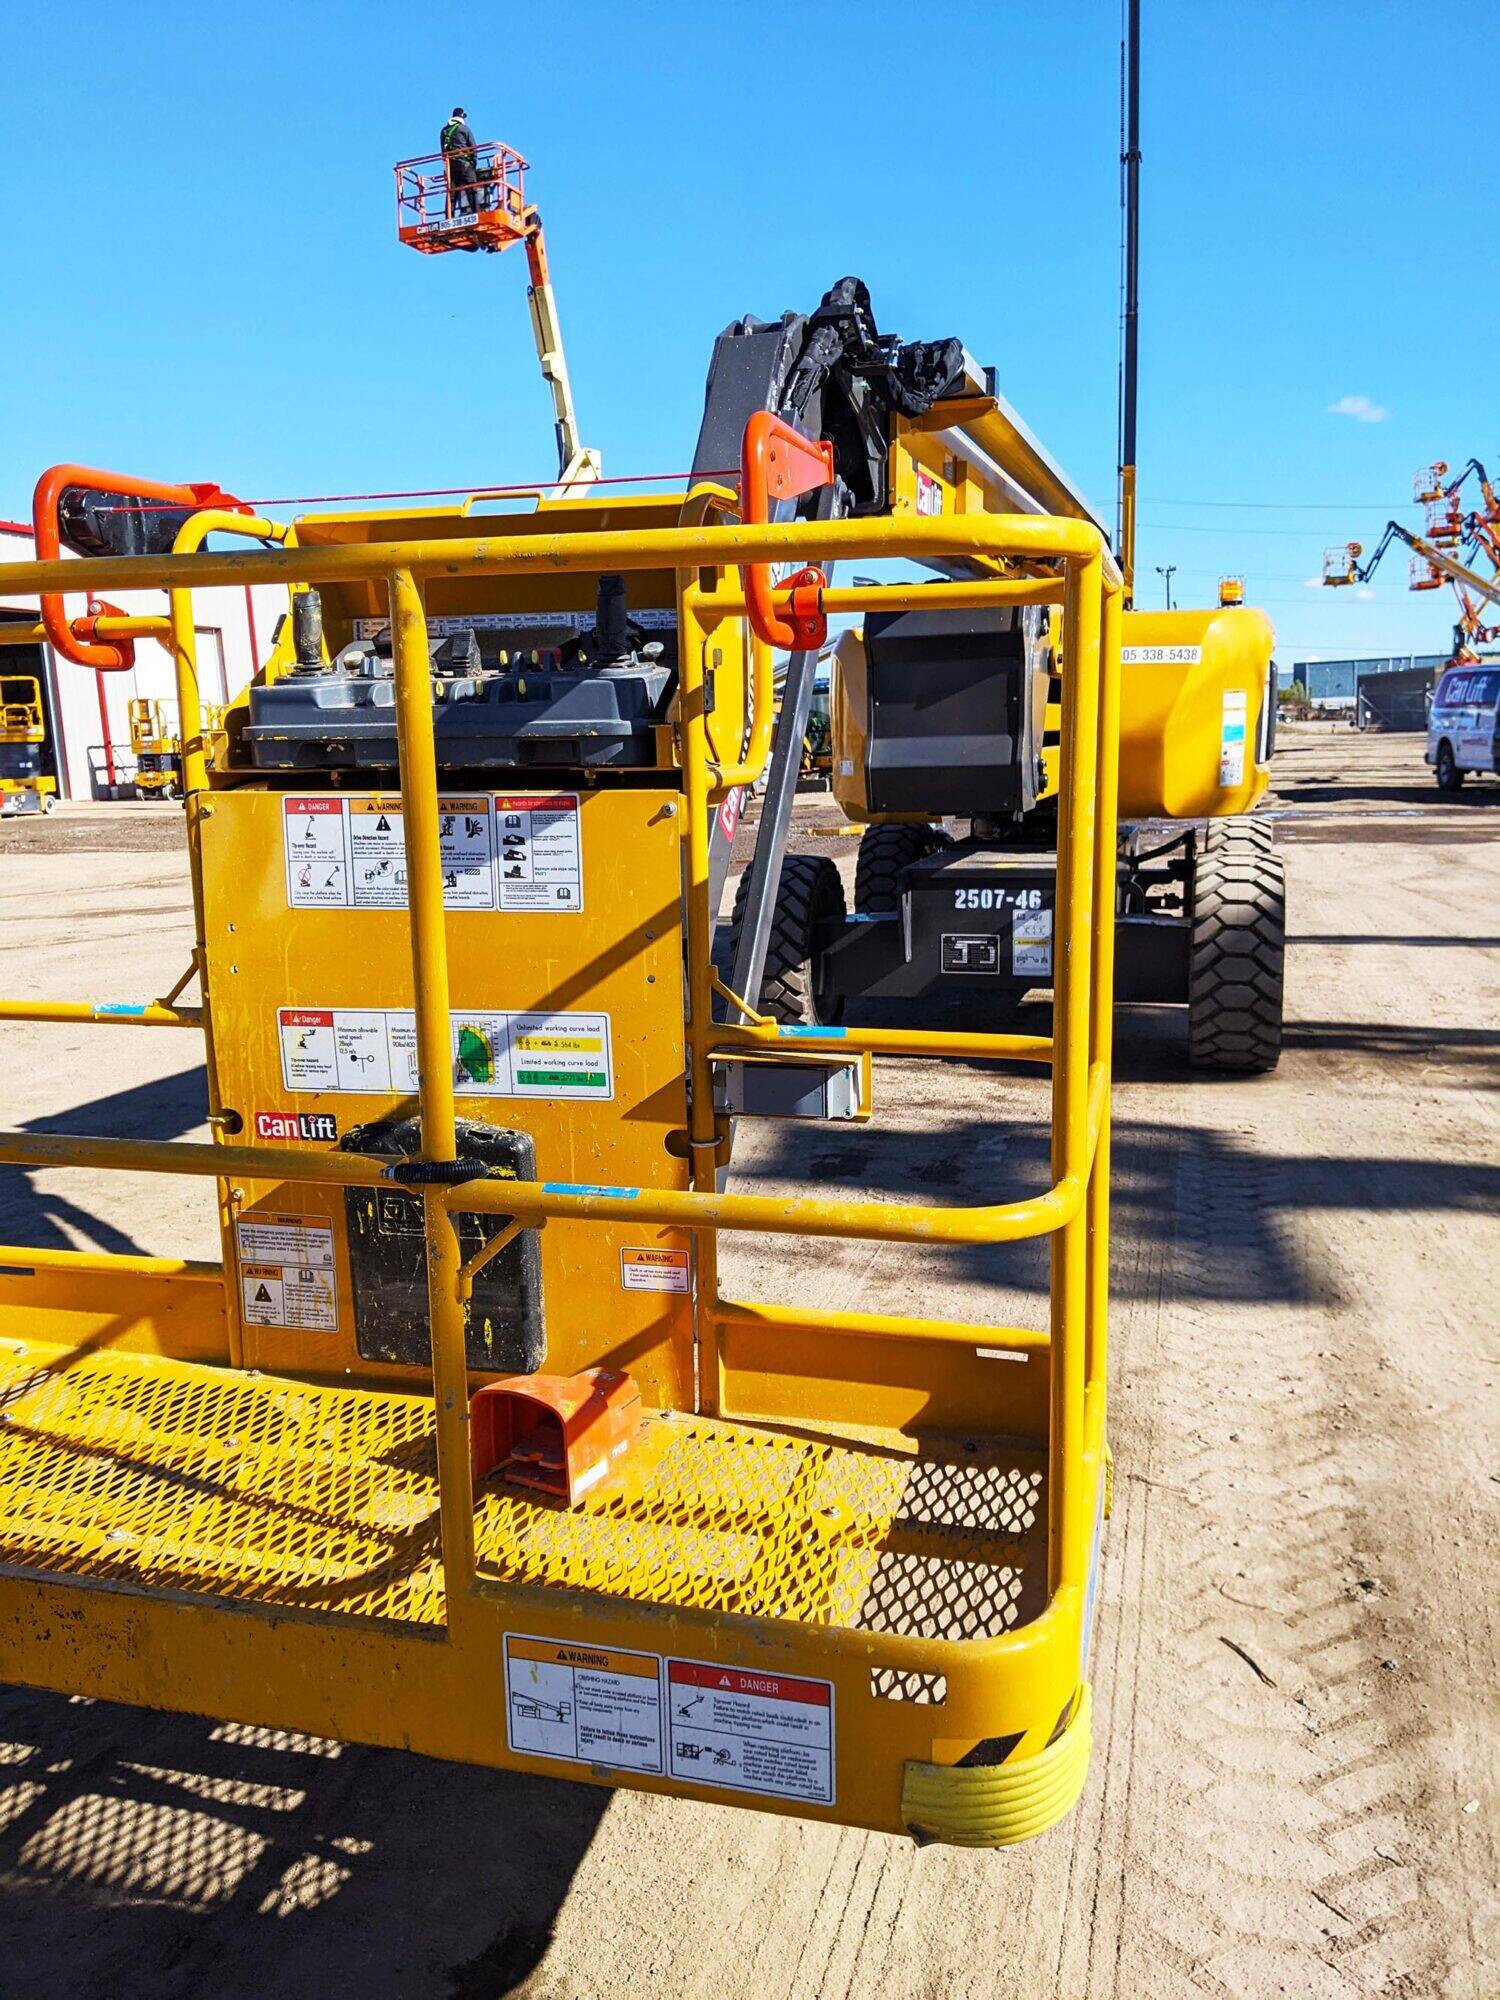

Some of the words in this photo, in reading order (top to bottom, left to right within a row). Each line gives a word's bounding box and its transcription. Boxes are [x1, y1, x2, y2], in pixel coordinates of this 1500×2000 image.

[1122, 648, 1198, 661] 05-338-5438
[308, 802, 330, 811] DANGER
[450, 802, 478, 811] WARNING
[954, 889, 1042, 910] 2507-46
[302, 1016, 321, 1025] Danger
[543, 1059, 566, 1067] working
[258, 1115, 334, 1138] CanLift
[646, 1254, 673, 1262] WARNING
[568, 1650, 609, 1667] WARNING
[740, 1678, 779, 1694] DANGER
[580, 1725, 595, 1733] Failure
[616, 1731, 628, 1739] these
[629, 1733, 655, 1743] instructions
[631, 1740, 648, 1748] serious
